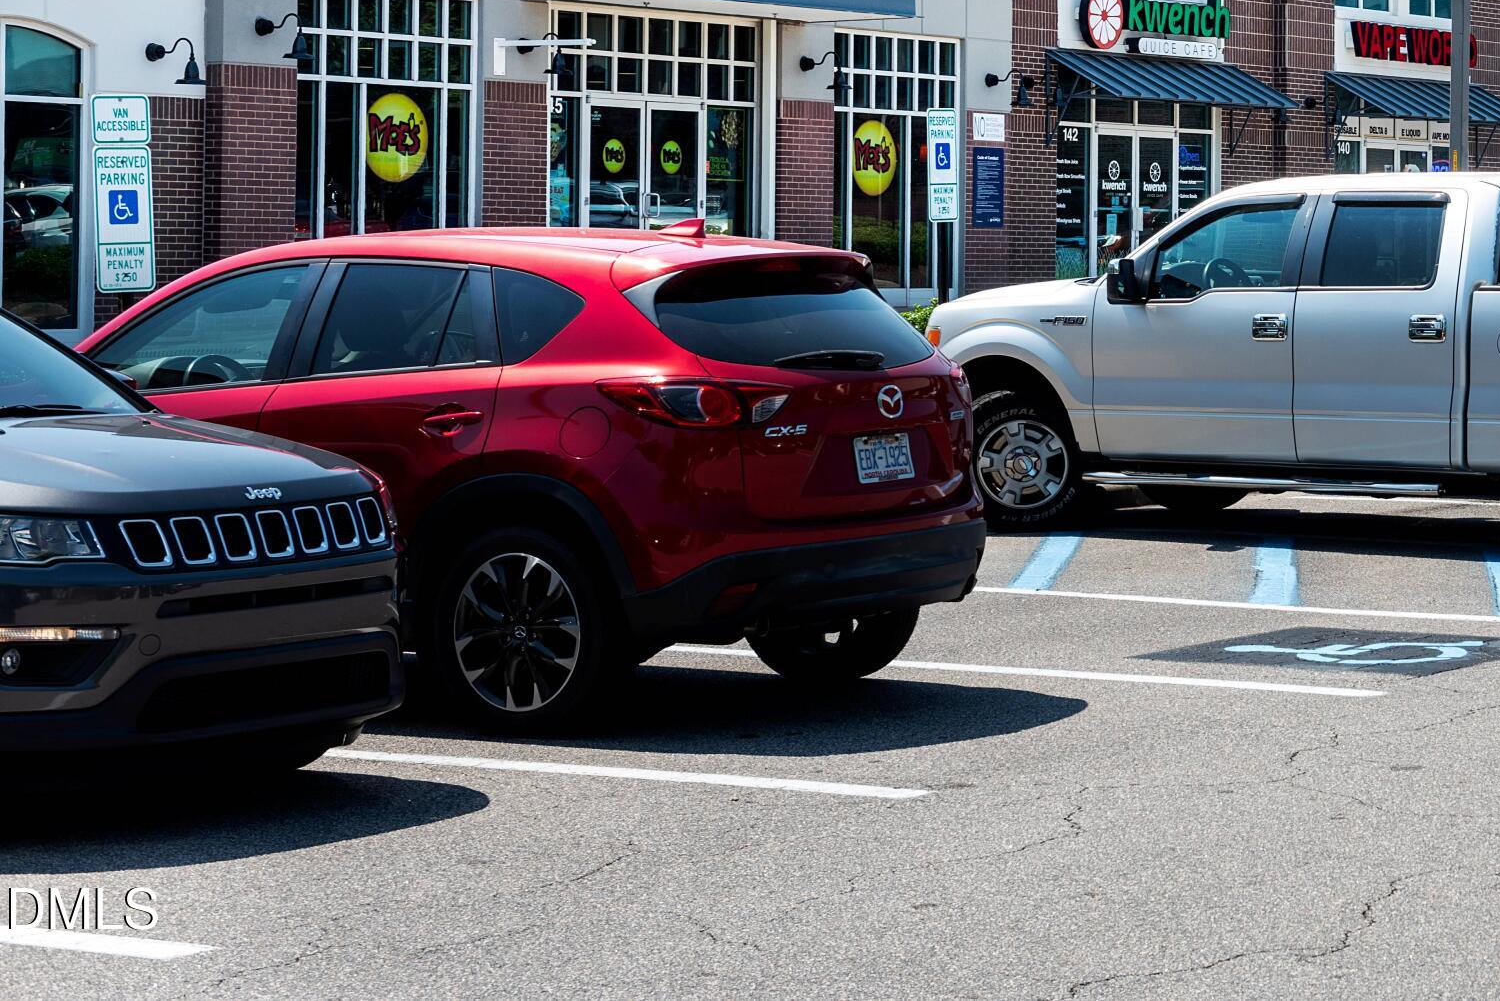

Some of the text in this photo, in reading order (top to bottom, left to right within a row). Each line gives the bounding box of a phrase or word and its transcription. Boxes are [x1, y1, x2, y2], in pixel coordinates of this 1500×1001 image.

[1354, 21, 1407, 62] VAPE
[1142, 42, 1214, 57] JUICE CAFE
[113, 108, 128, 118] VAN
[97, 120, 146, 131] ACCESSIBLE
[929, 116, 954, 126] RESERVED
[930, 130, 954, 139] PARKING
[1063, 128, 1079, 141] 142
[1370, 126, 1383, 134] DELTA
[1406, 129, 1421, 137] LIQUID
[1337, 142, 1350, 154] 140
[97, 156, 146, 168] RESERVED
[100, 173, 145, 185] PARKING
[1102, 180, 1126, 190] kwench
[1143, 182, 1167, 192] kwench
[106, 247, 145, 257] MAXIMUM
[107, 260, 144, 269] PENALTY
[977, 409, 1037, 434] GENERAL
[765, 425, 807, 436] CX-5
[859, 445, 910, 470] EBX-1925
[245, 487, 282, 499] Jeep
